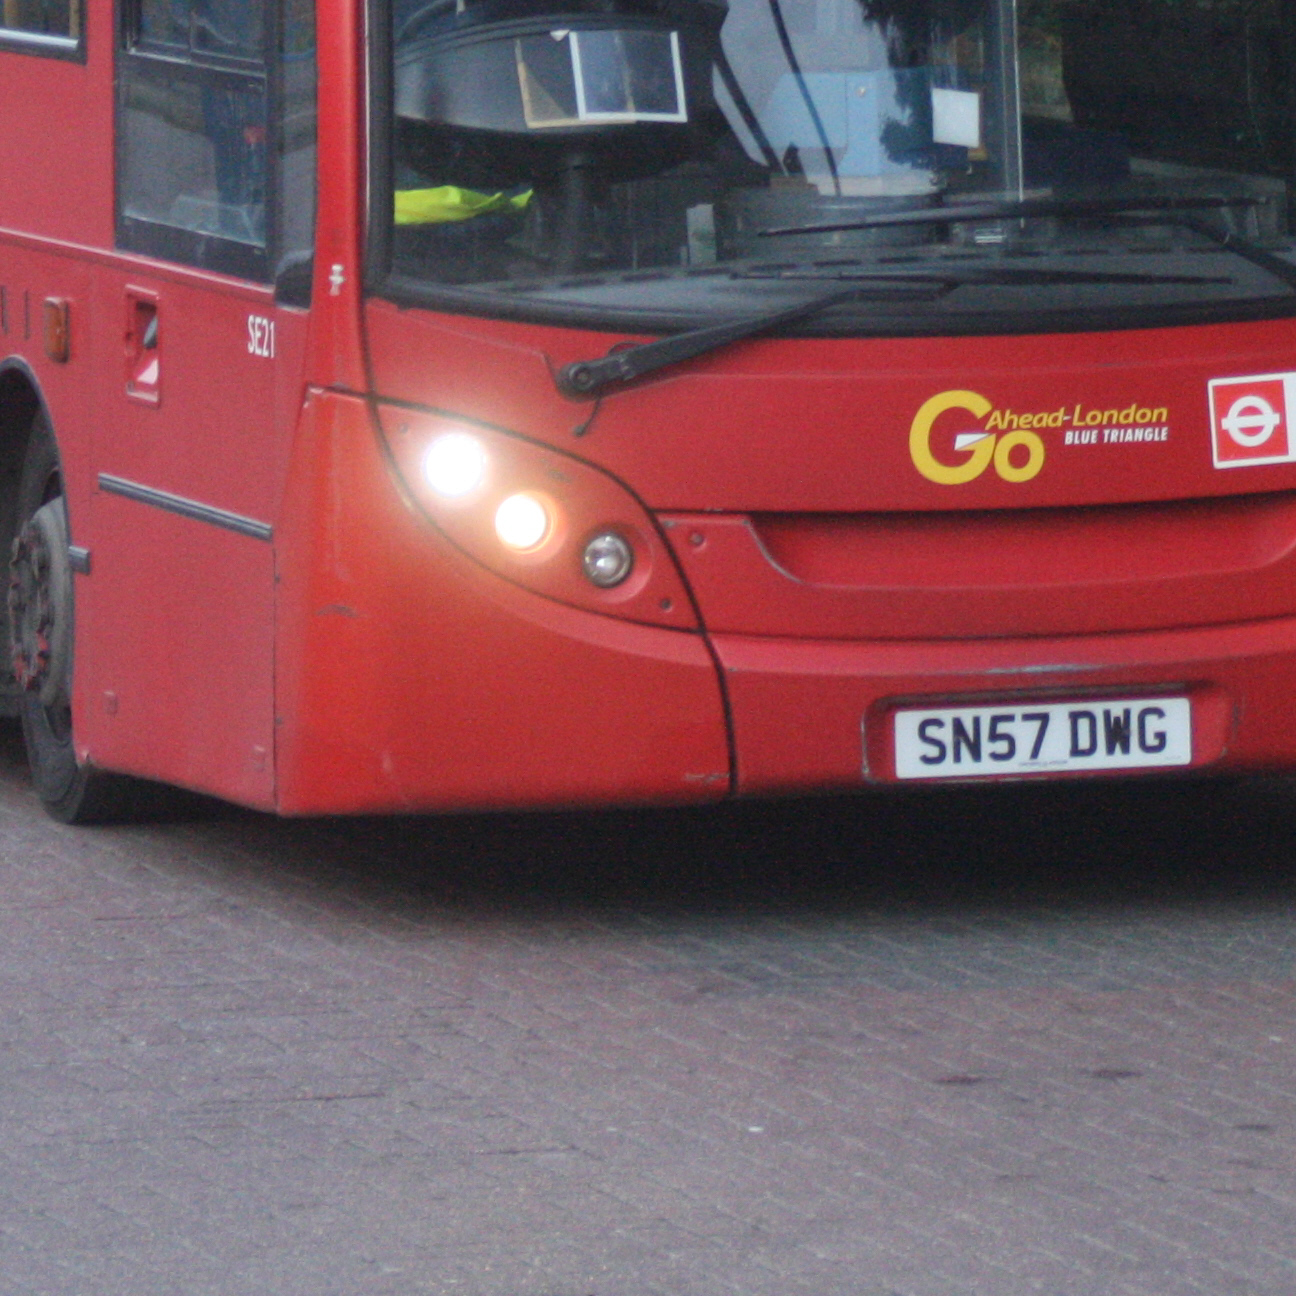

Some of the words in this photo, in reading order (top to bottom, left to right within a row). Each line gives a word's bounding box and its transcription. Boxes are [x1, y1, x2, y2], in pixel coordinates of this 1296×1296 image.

[247, 314, 275, 358] SE21
[908, 389, 1046, 486] Go
[985, 403, 1169, 431] Ahead-London
[1064, 429, 1098, 445] BLUE
[1103, 426, 1169, 443] TRIANGLE
[917, 712, 1051, 766] SN57
[1068, 706, 1168, 758] DWG
